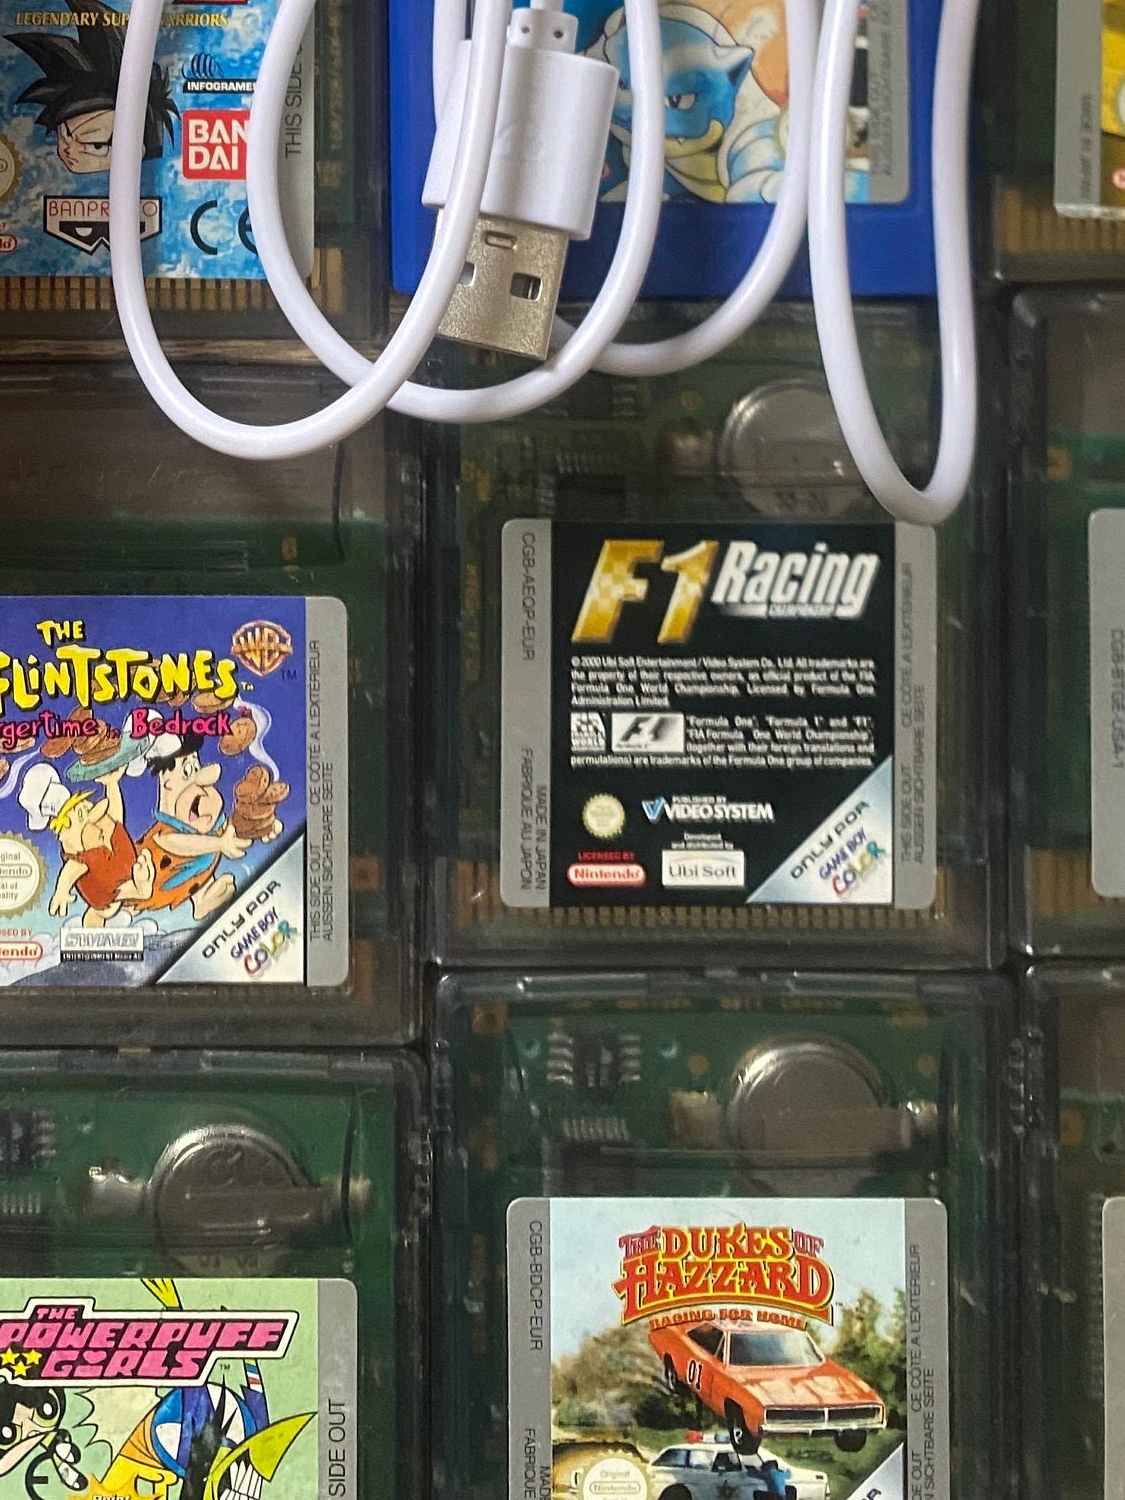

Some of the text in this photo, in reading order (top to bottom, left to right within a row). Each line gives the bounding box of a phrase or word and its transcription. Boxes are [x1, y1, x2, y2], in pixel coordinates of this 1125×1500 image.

[16, 12, 99, 28] LEGENDARY
[284, 111, 302, 159] THIS
[188, 146, 240, 171] DAI
[571, 539, 880, 644] F1 Racing
[37, 619, 85, 646] THE
[130, 708, 233, 739] Bedrock
[574, 867, 641, 880] Nintendo
[668, 864, 737, 879] Ubi Soft
[791, 833, 835, 879] ONLY
[321, 886, 333, 942] AUSSEN
[202, 915, 245, 958] ONLY
[618, 1225, 825, 1263] THE DUKES OF
[529, 1220, 544, 1352] CGB-BDCP-EUR
[613, 1250, 837, 1326] HAZZARD
[35, 1307, 79, 1320] THE
[649, 1308, 808, 1331] RACING FOR HOME
[686, 1358, 703, 1391] 01
[329, 1398, 347, 1498] SIDE OUT
[523, 1429, 536, 1499] FABRIQUE
[593, 1482, 639, 1493] Nintendo
